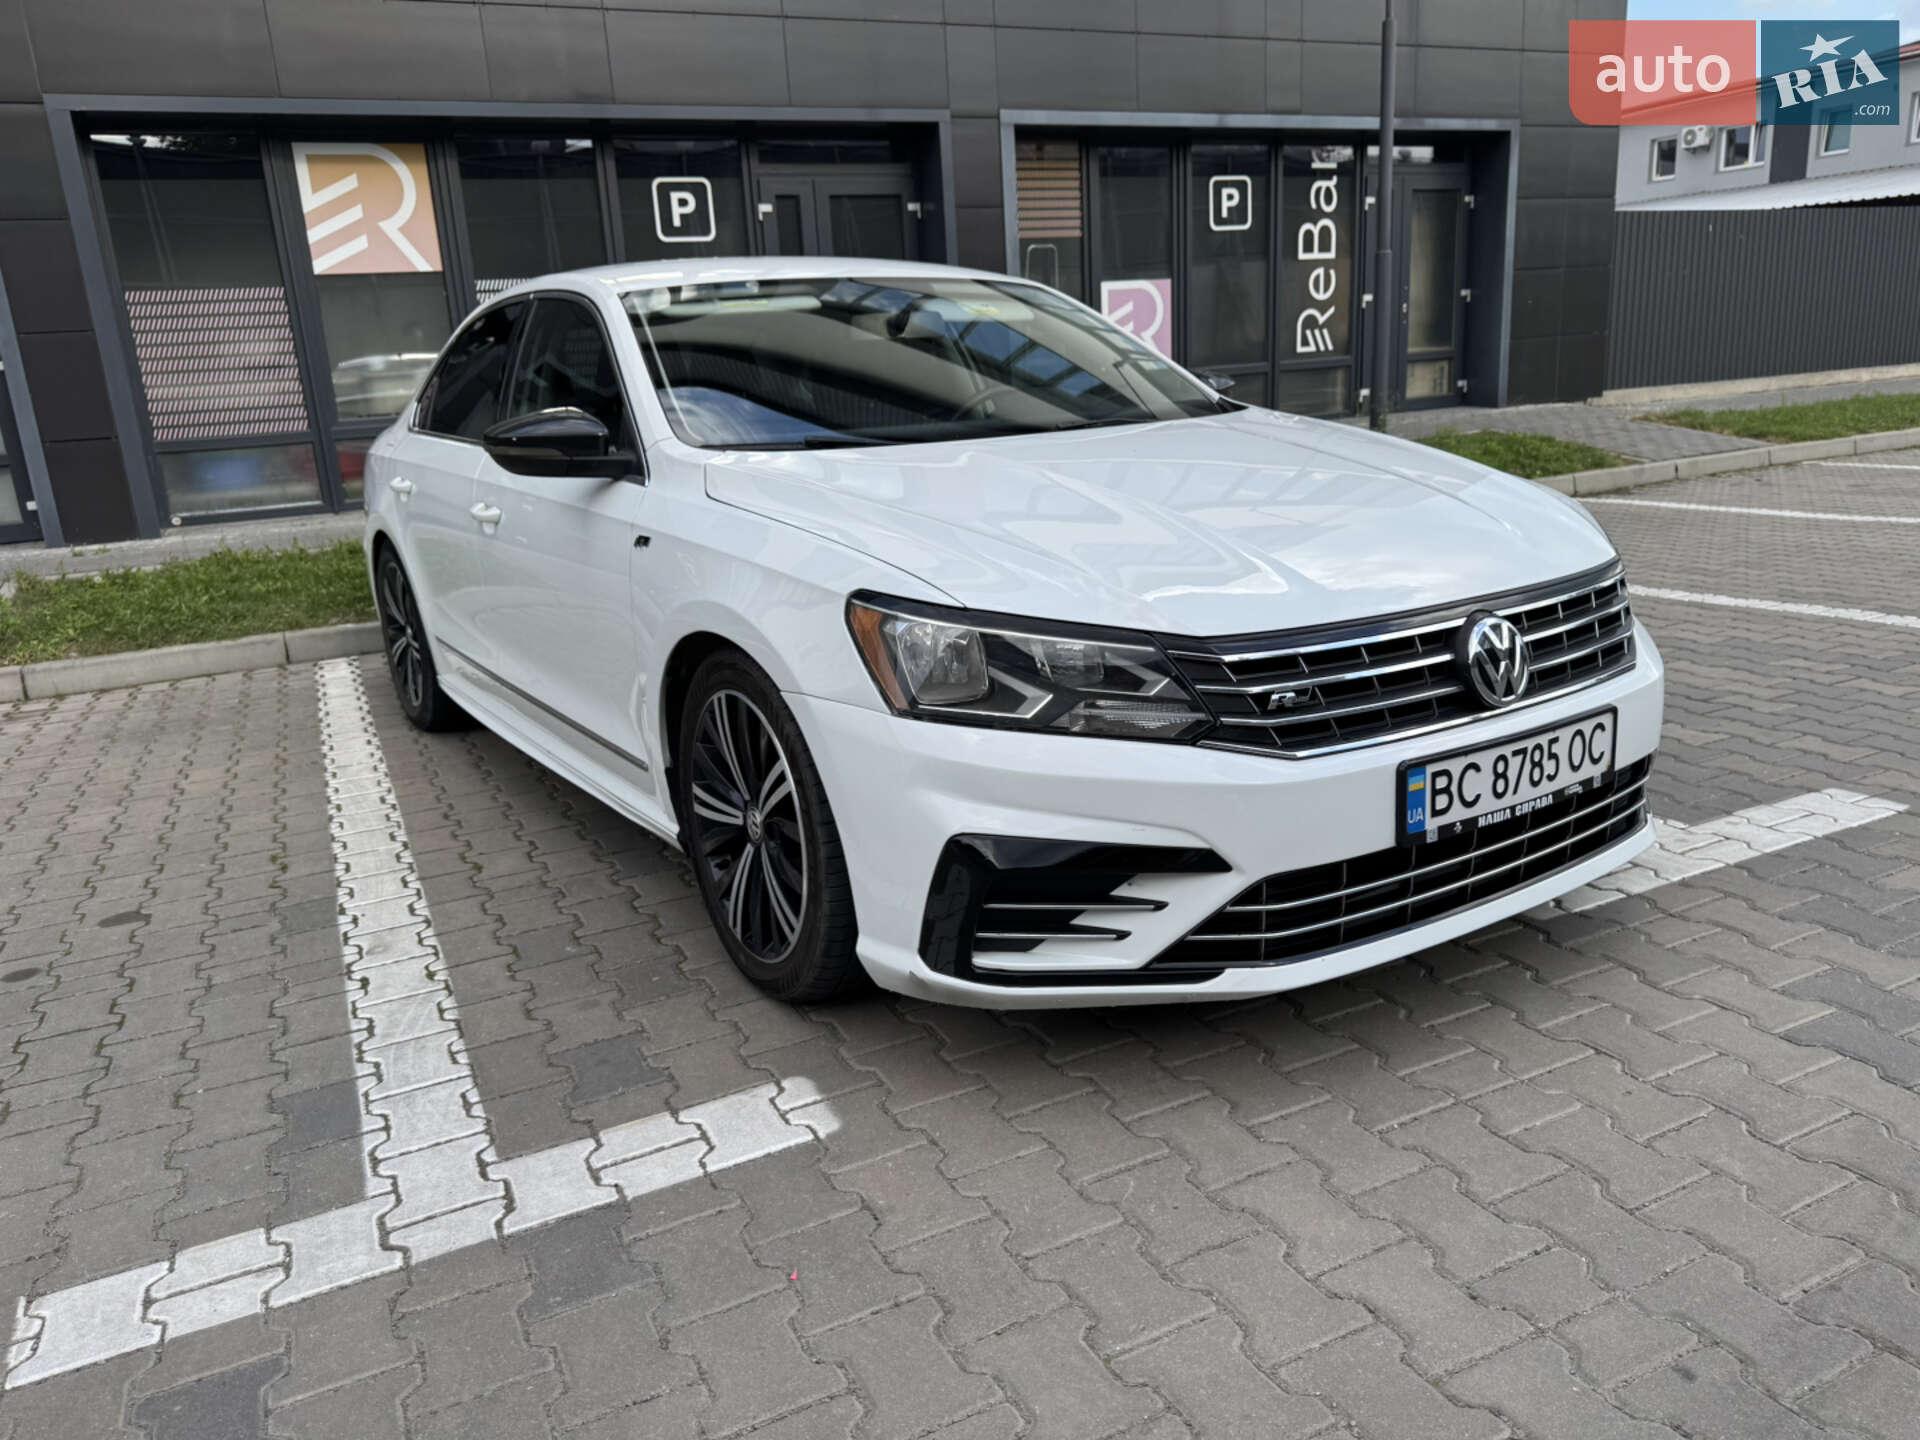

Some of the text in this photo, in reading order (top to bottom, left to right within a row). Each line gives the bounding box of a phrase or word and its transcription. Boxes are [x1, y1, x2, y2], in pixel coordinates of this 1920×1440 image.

[669, 190, 697, 228] P
[1221, 187, 1240, 219] P
[1296, 148, 1338, 353] ReBar
[1430, 721, 1606, 818] BC 8785 OC
[1407, 807, 1424, 825] UA
